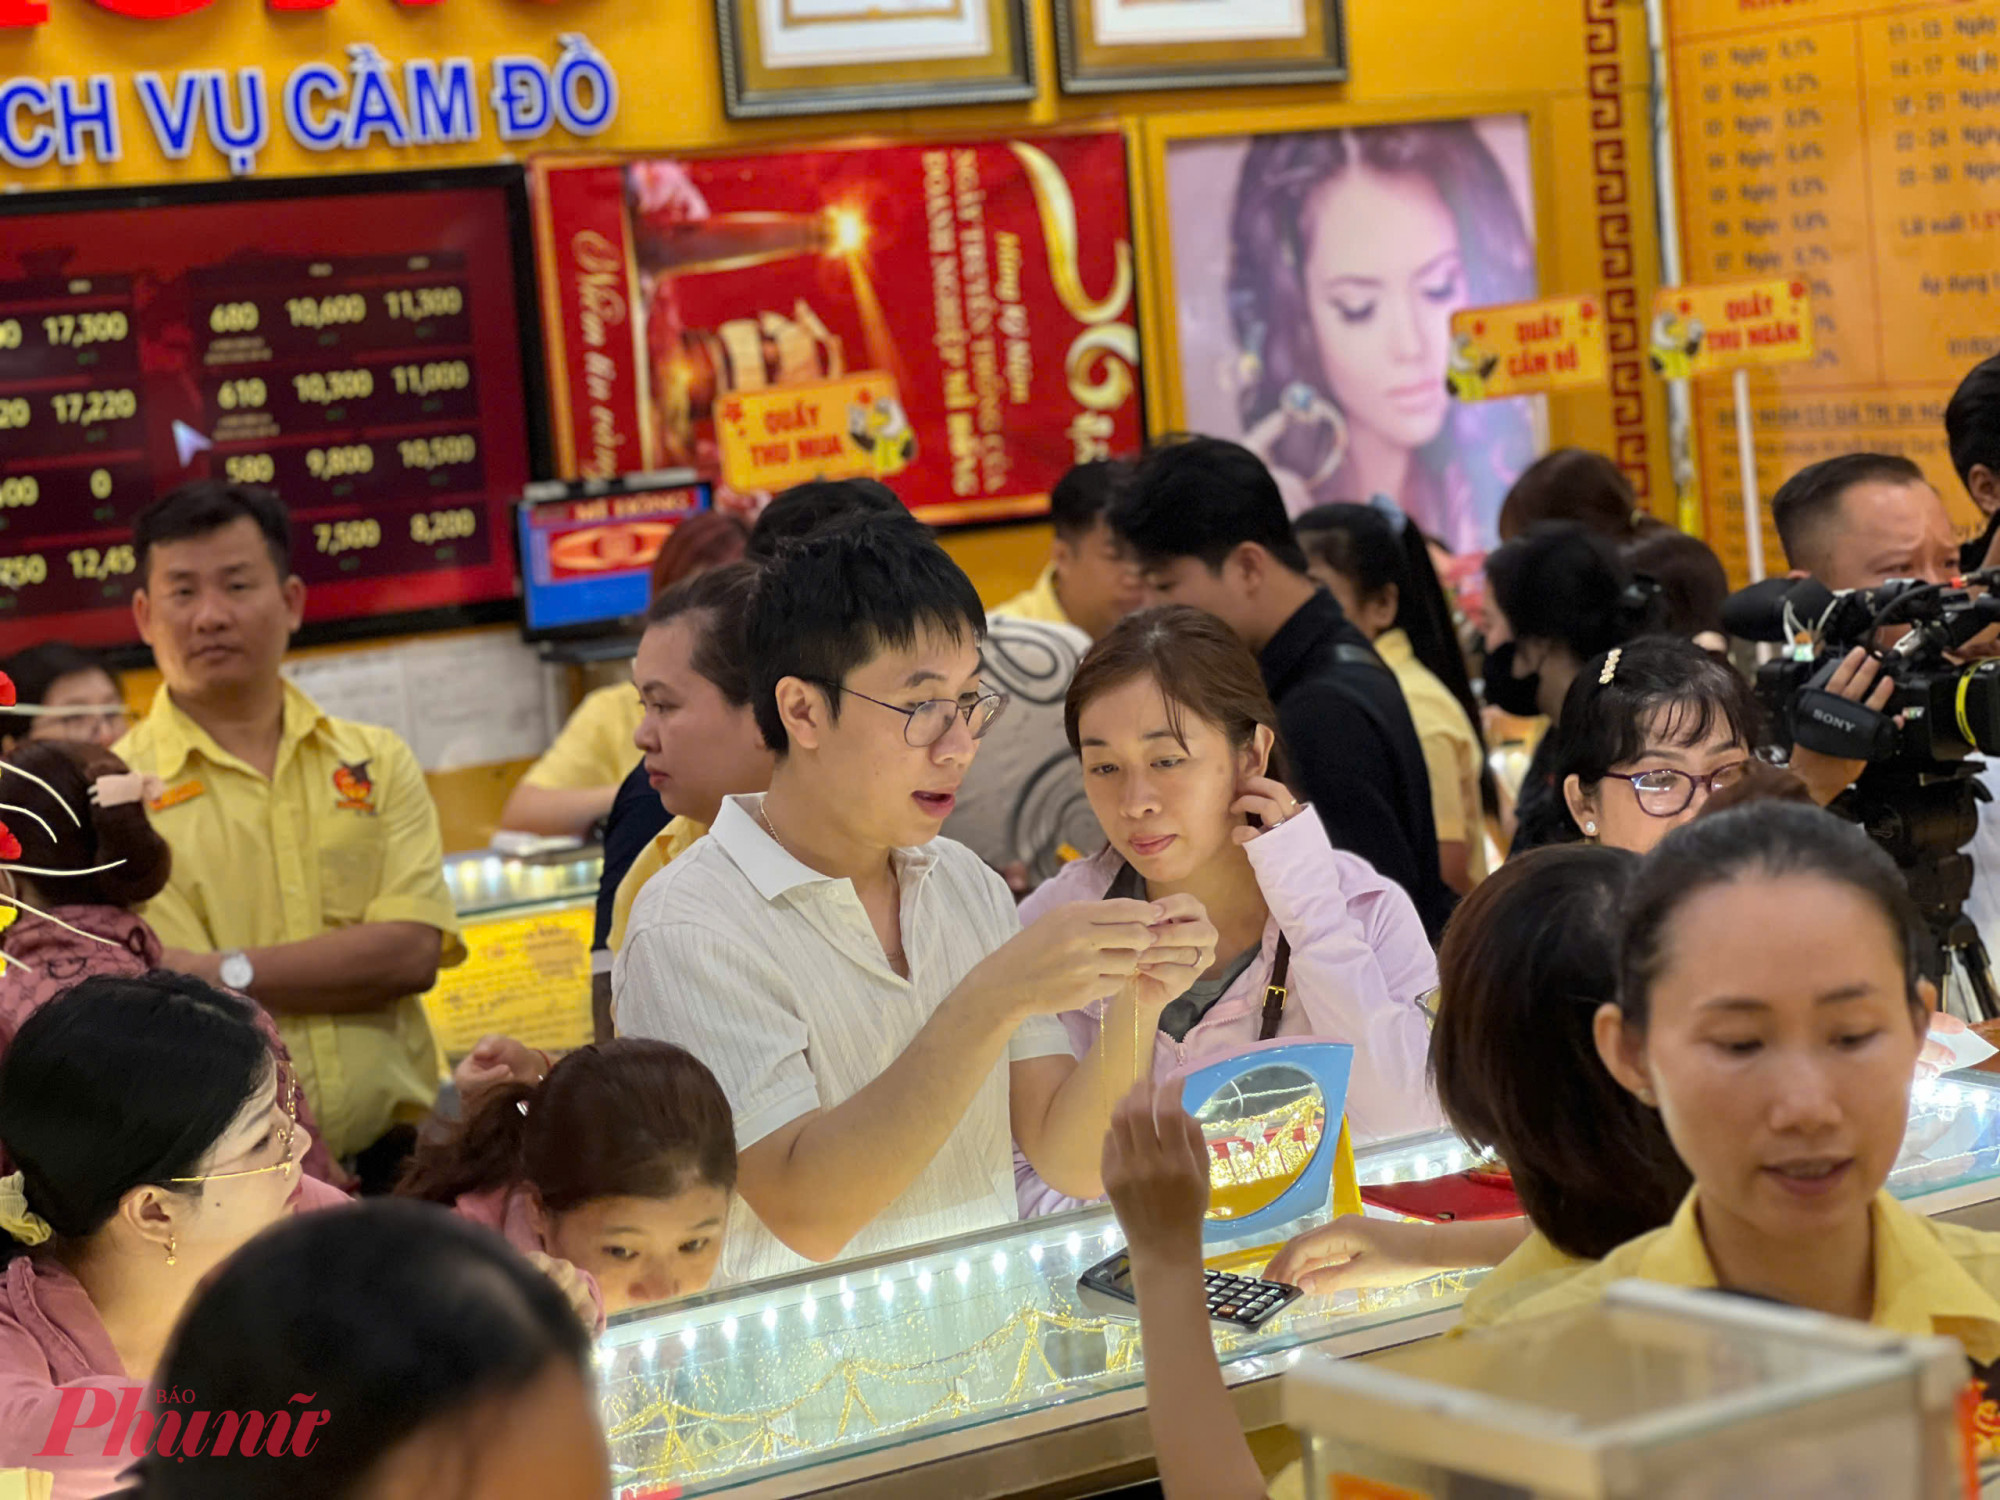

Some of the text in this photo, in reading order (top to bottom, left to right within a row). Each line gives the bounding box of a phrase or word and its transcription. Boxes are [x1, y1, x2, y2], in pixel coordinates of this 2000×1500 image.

[136, 67, 266, 176] VỤ
[285, 44, 480, 150] CẦM
[491, 33, 618, 139] ĐỒ
[43, 311, 128, 348] 17,300
[52, 388, 136, 426] 17,220
[90, 468, 112, 499] 0
[1812, 707, 1856, 733] SONY
